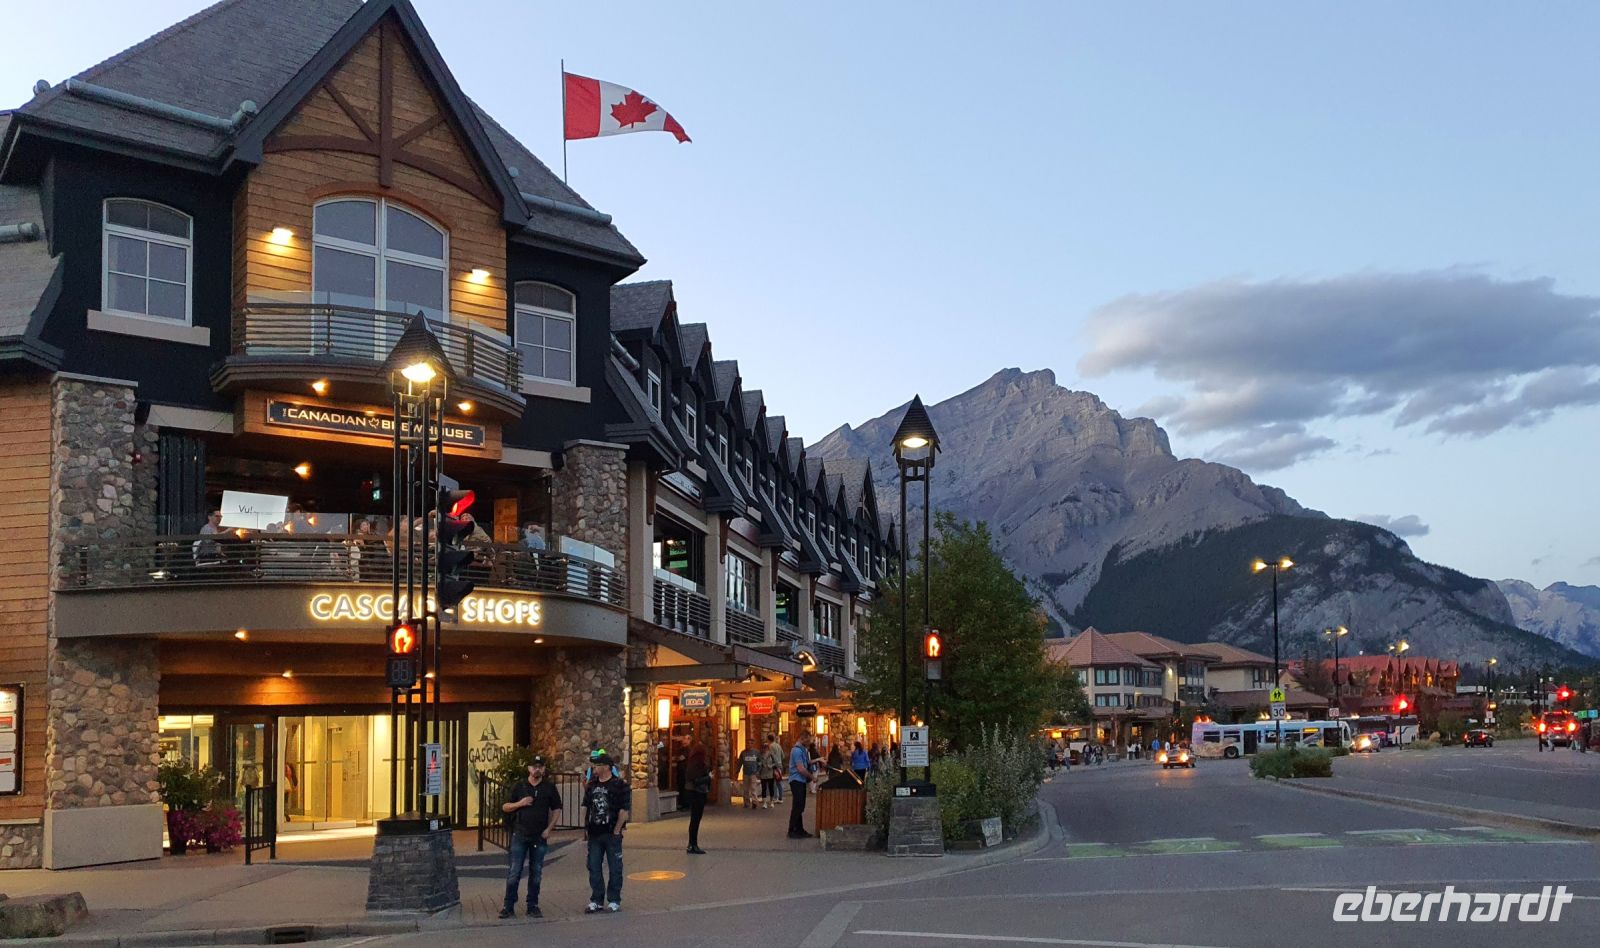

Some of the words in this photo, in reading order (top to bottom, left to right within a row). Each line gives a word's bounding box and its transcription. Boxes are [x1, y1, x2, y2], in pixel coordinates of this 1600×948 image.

[287, 407, 367, 427] CANADIAN
[462, 597, 542, 625] SHOPS
[1273, 707, 1285, 717] 30
